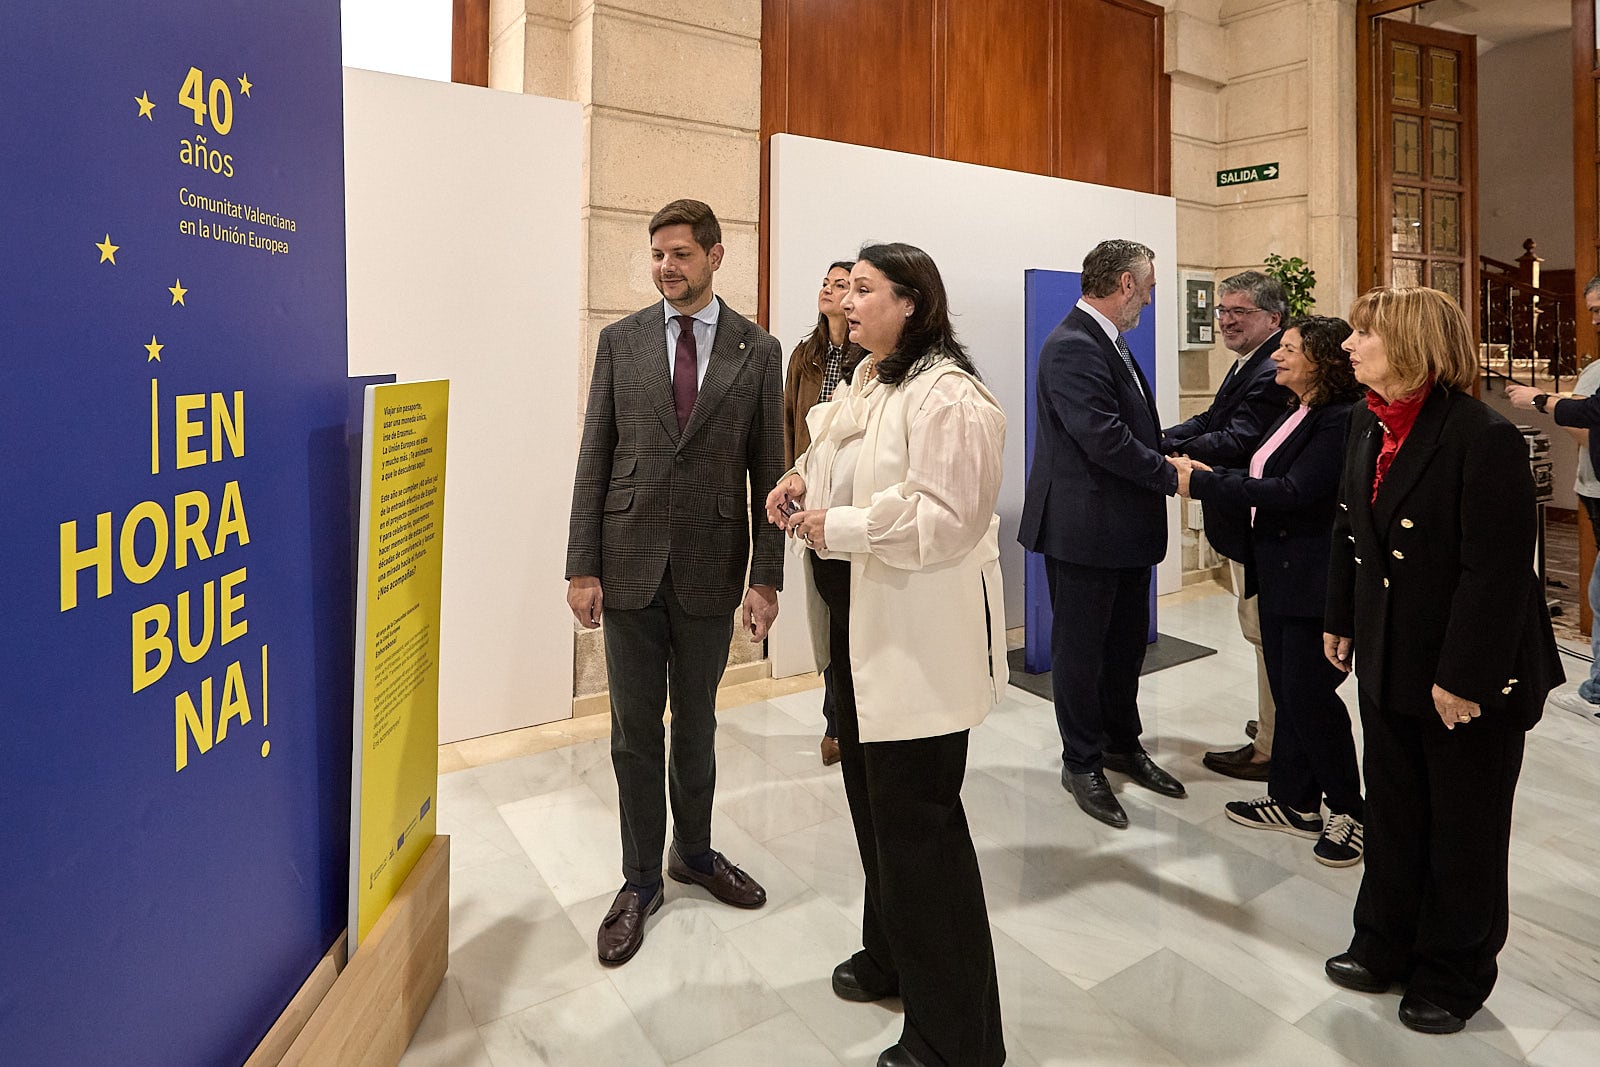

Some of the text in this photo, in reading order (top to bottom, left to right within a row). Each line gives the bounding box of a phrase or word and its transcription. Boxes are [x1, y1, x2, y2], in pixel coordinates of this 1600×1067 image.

[178, 66, 234, 136] 40
[179, 134, 235, 178] años
[1220, 169, 1258, 184] SALIDA
[179, 187, 297, 232] Comunitat Valenciana
[179, 219, 290, 255] en la Unión Europea
[384, 406, 396, 416] Viajar
[401, 415, 416, 424] moneda
[391, 431, 396, 439] de
[388, 442, 400, 453] Unión
[400, 440, 415, 449] Europea
[382, 462, 385, 470] y
[386, 457, 399, 466] mucho
[381, 494, 390, 503] Este
[403, 483, 418, 494] cumplen
[380, 508, 385, 516] de
[391, 500, 405, 511] entrada
[386, 518, 390, 526] el
[390, 512, 407, 526] proyecto
[382, 532, 392, 543] para
[59, 480, 251, 612] HORA
[379, 545, 390, 556] hacer
[391, 536, 407, 549] memoria
[378, 555, 395, 569] décadas
[396, 551, 400, 559] de
[387, 564, 400, 577] mirada
[131, 567, 249, 694] BUE
